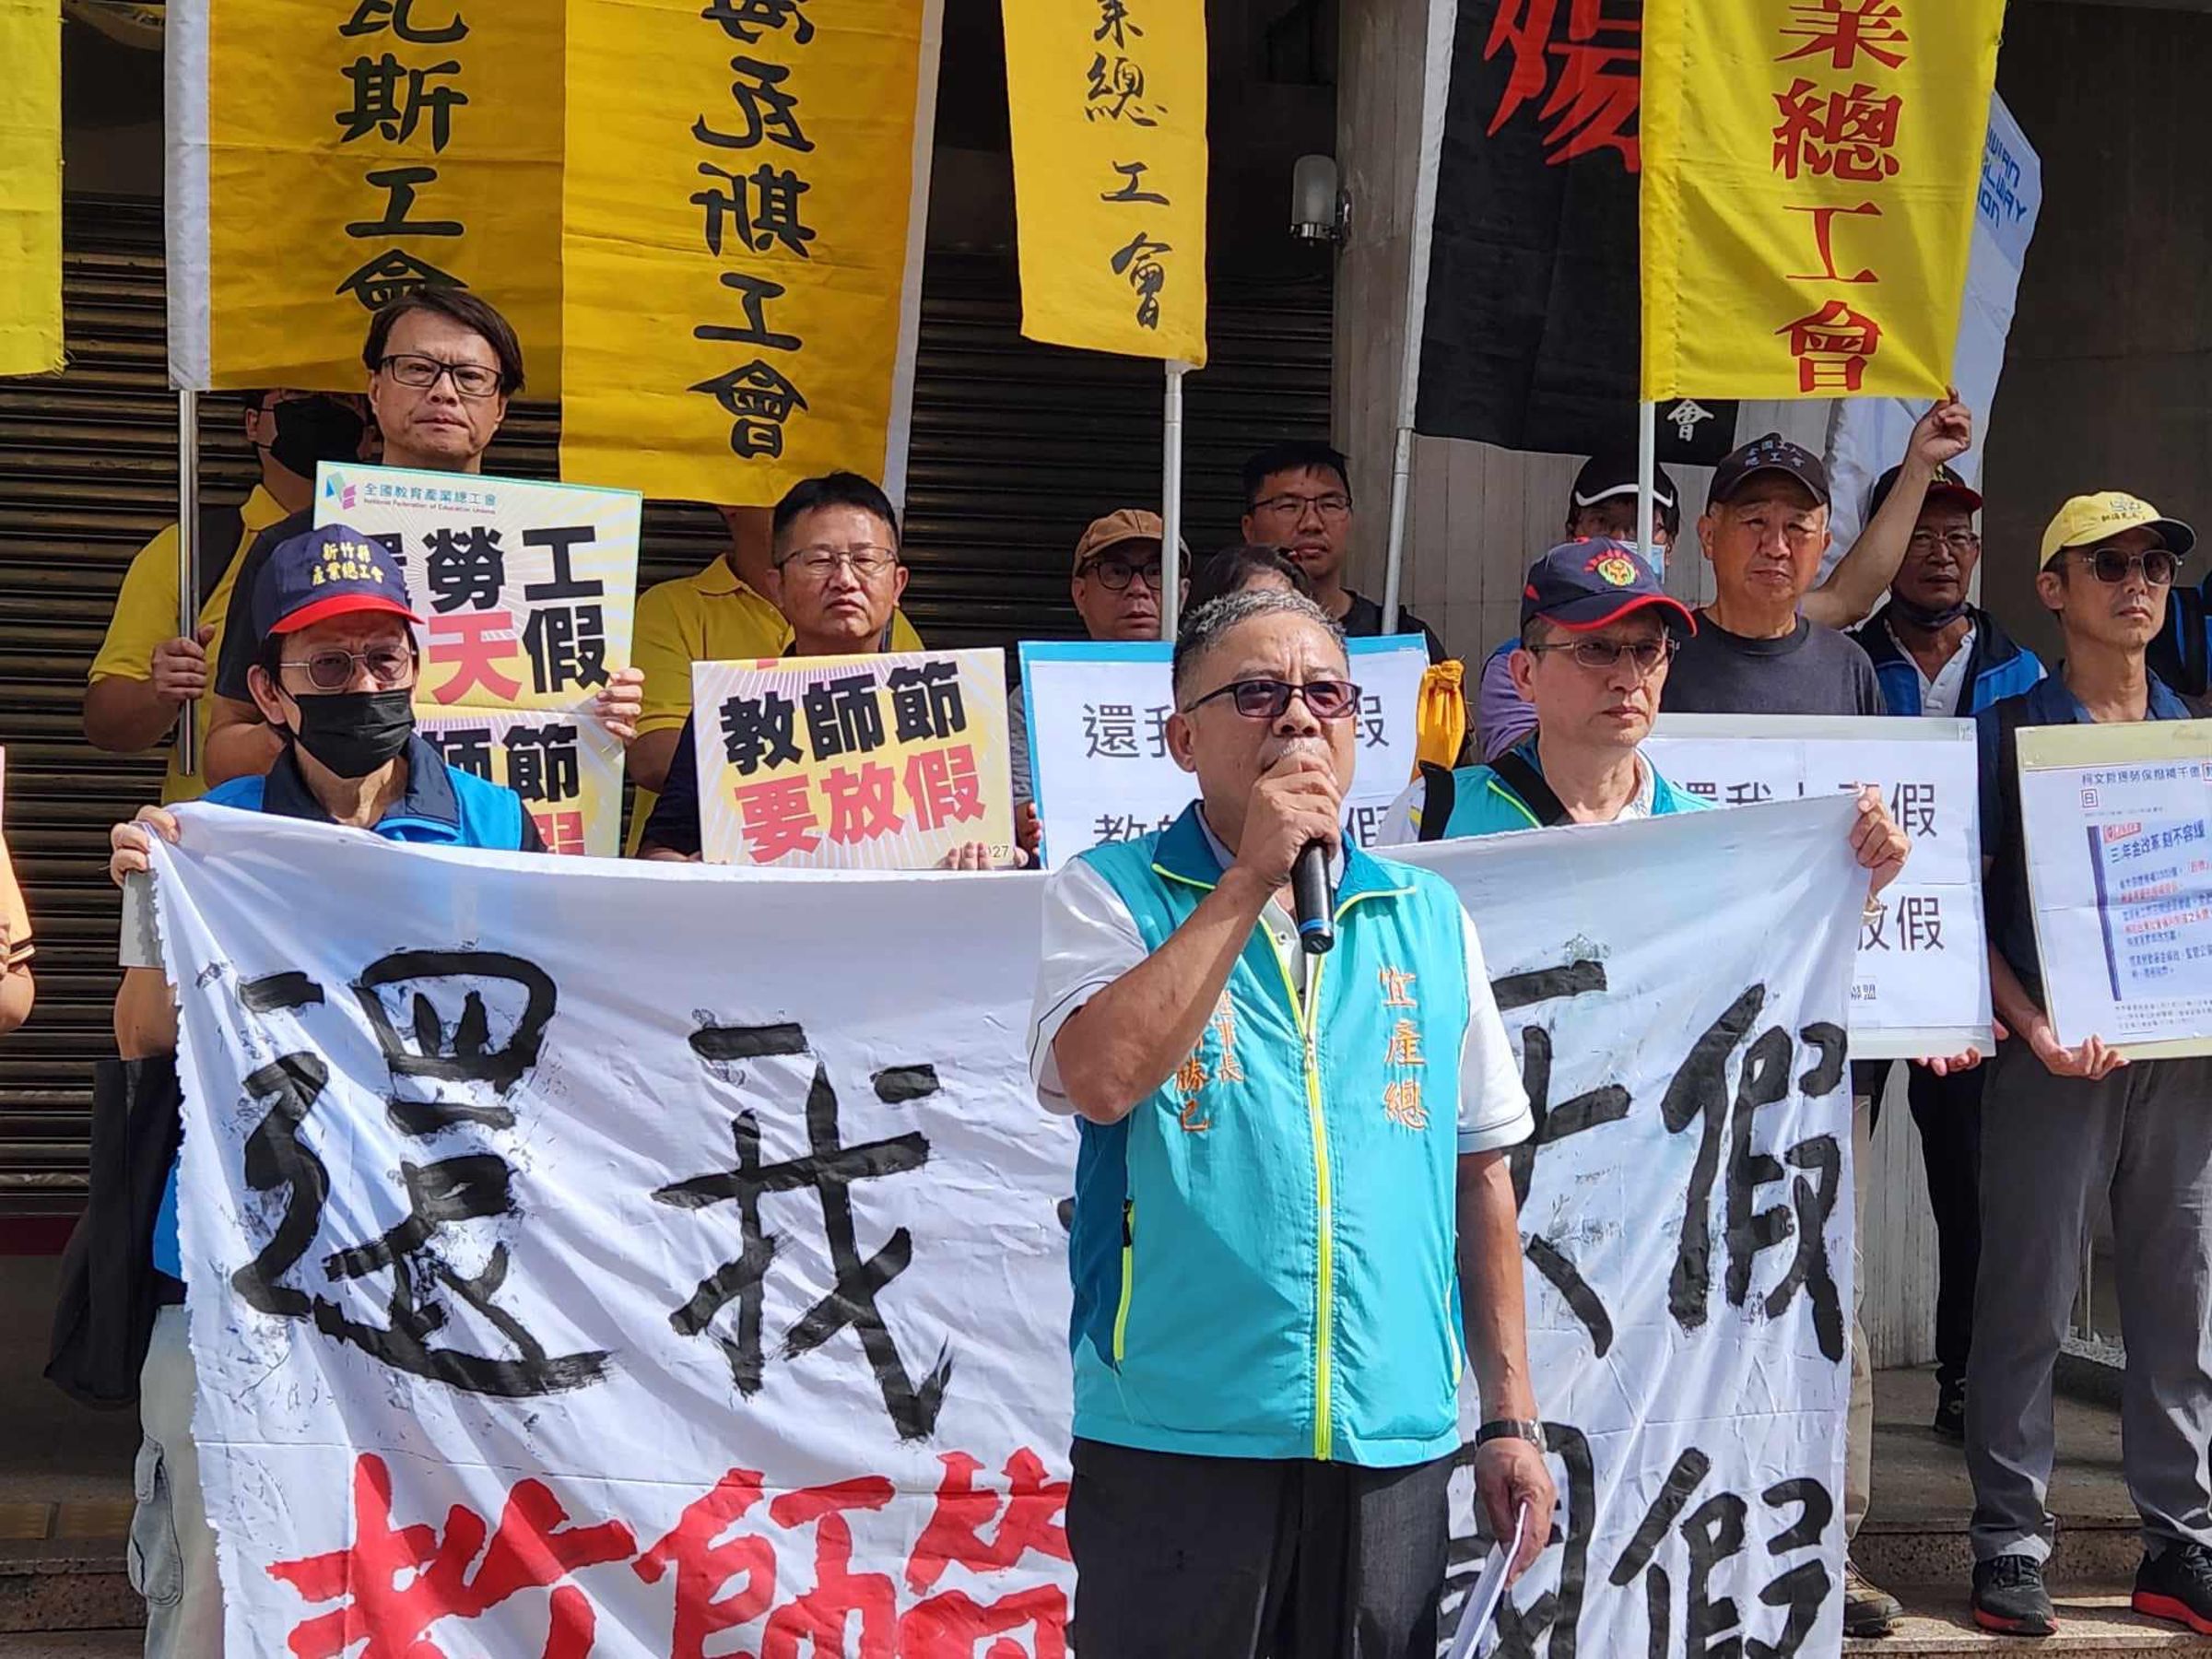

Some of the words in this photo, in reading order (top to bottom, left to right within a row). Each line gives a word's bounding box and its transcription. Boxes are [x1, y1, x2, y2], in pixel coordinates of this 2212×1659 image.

[1771, 0, 1911, 394] 業總工會
[363, 482, 497, 506] 全國教育產業總工會
[719, 660, 968, 776] 教師節
[734, 744, 987, 865] 要放假
